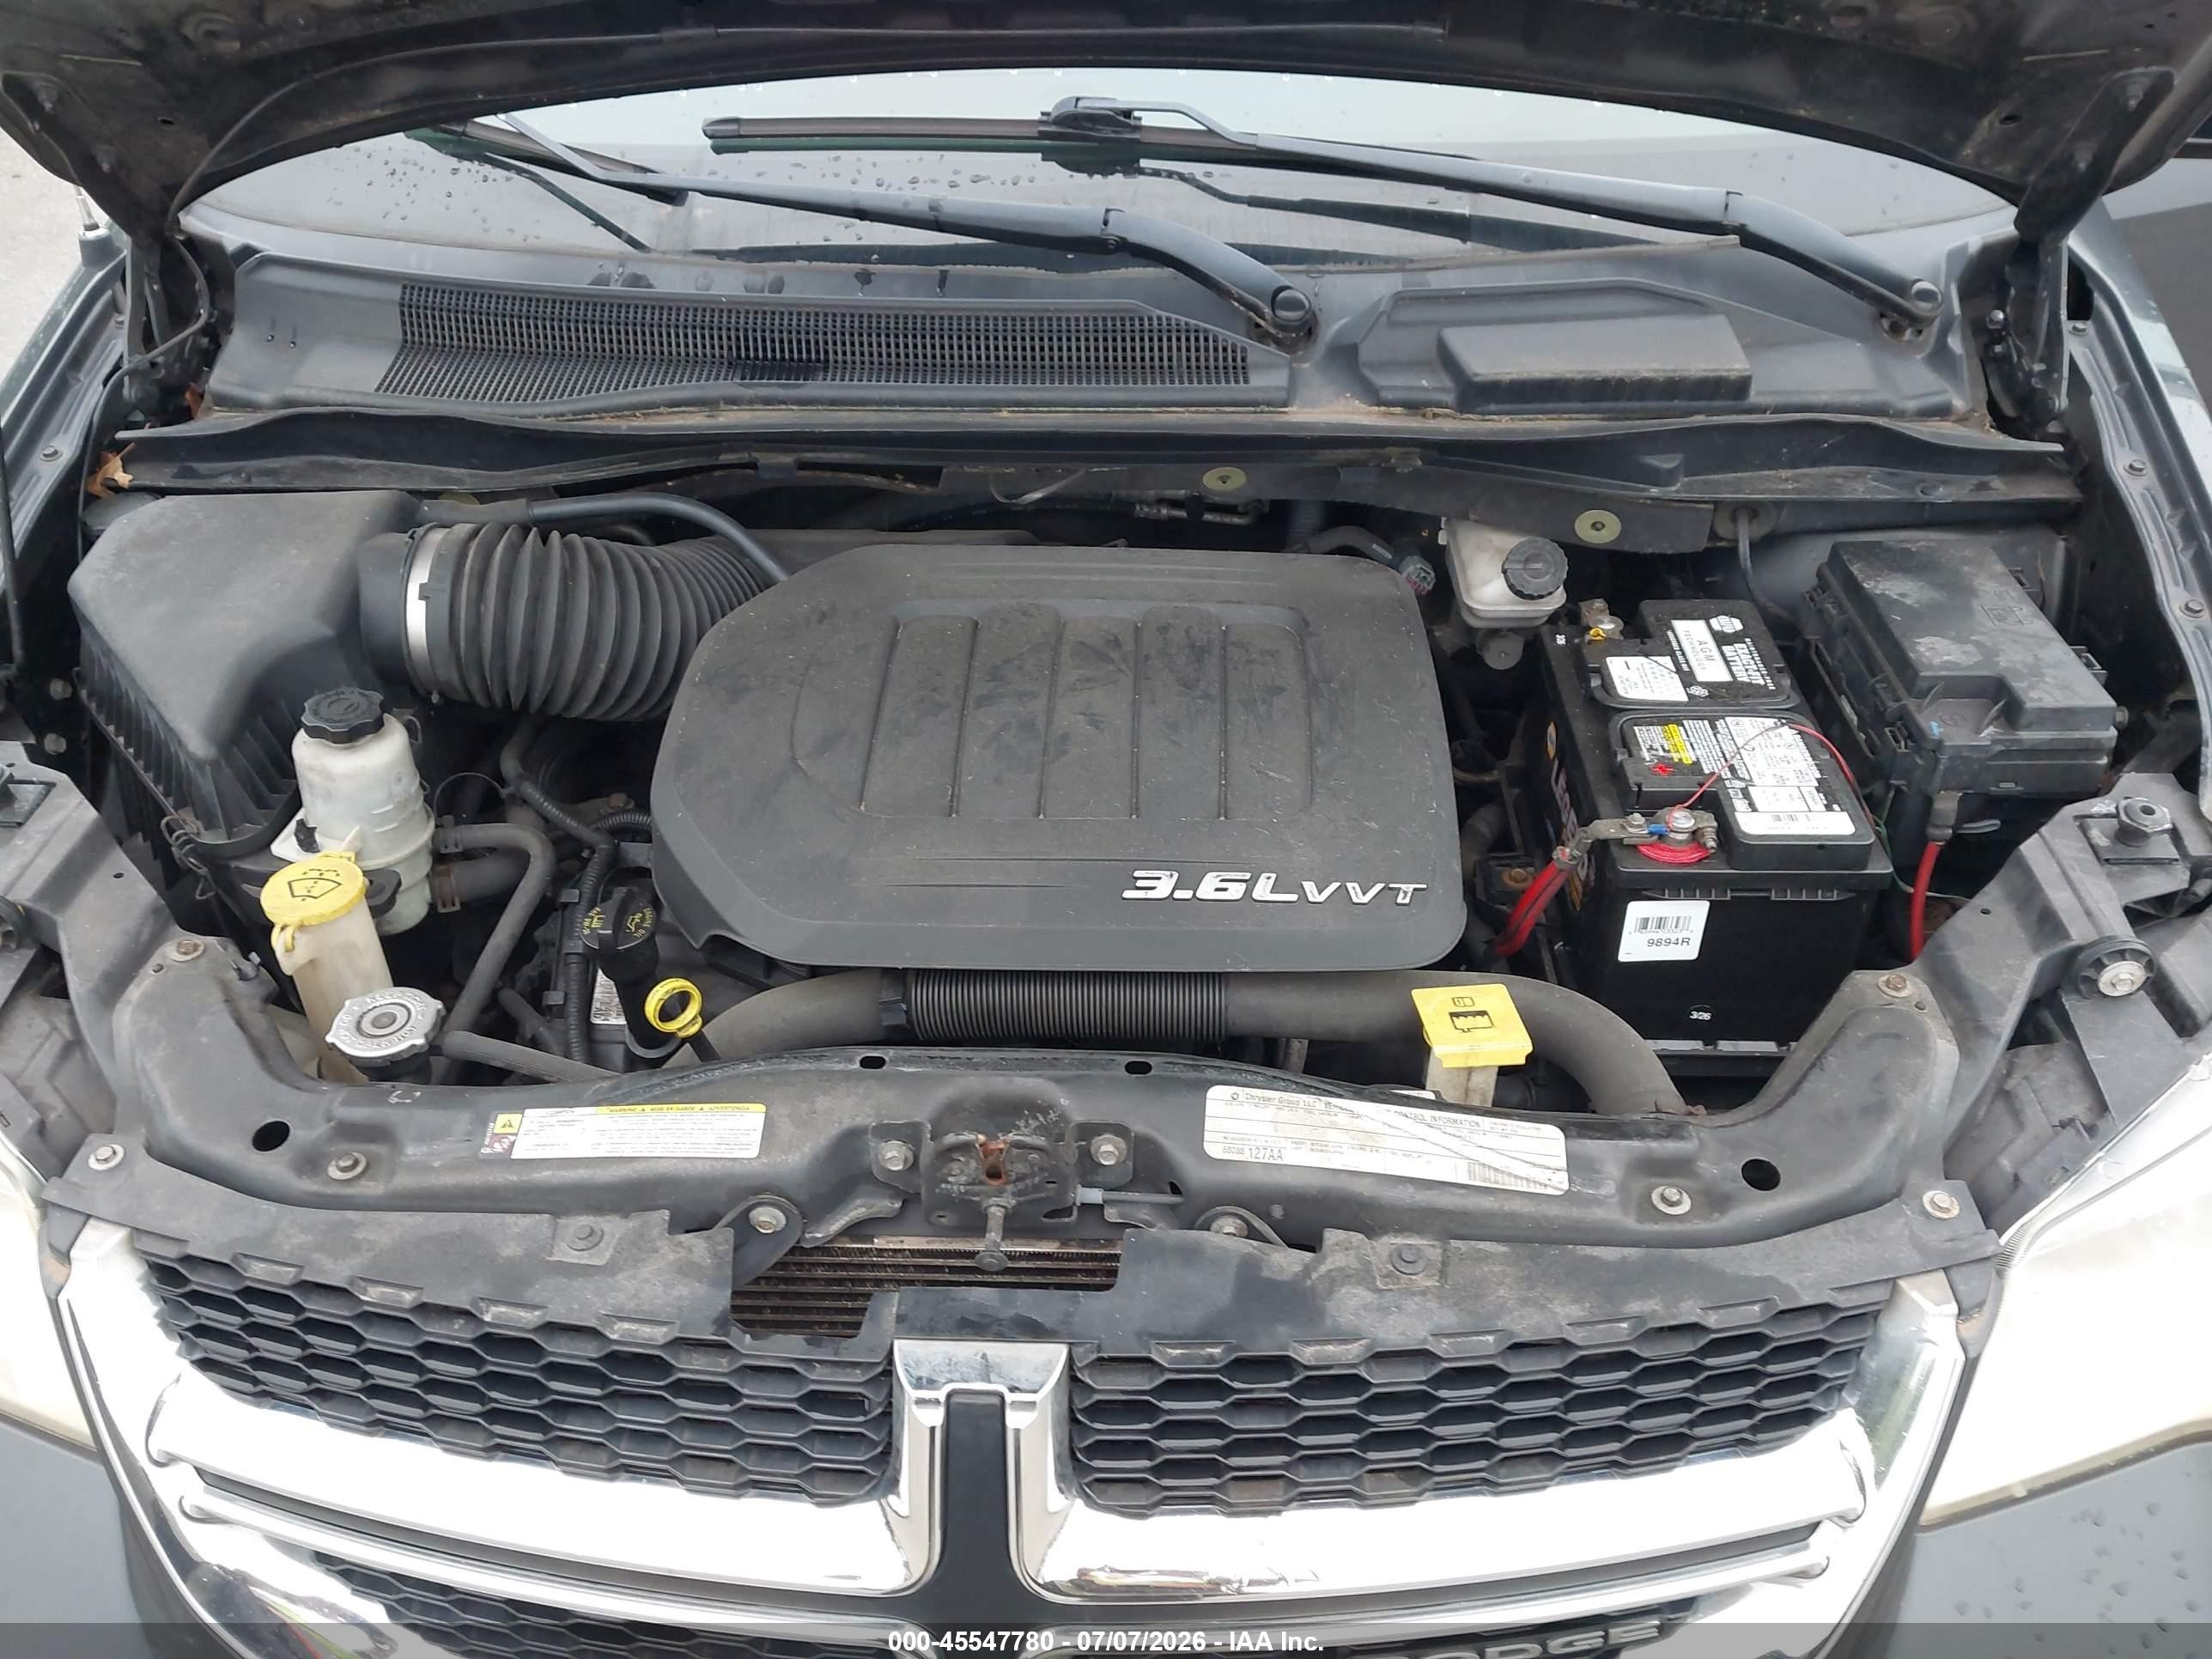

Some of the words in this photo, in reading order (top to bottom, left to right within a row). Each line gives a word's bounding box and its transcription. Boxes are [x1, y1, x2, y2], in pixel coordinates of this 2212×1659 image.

[1696, 640, 1717, 661] AGM
[1647, 937, 1691, 947] 9894R
[1245, 1091, 1276, 1103] Chrysler
[1248, 1146, 1285, 1162] 127AA
